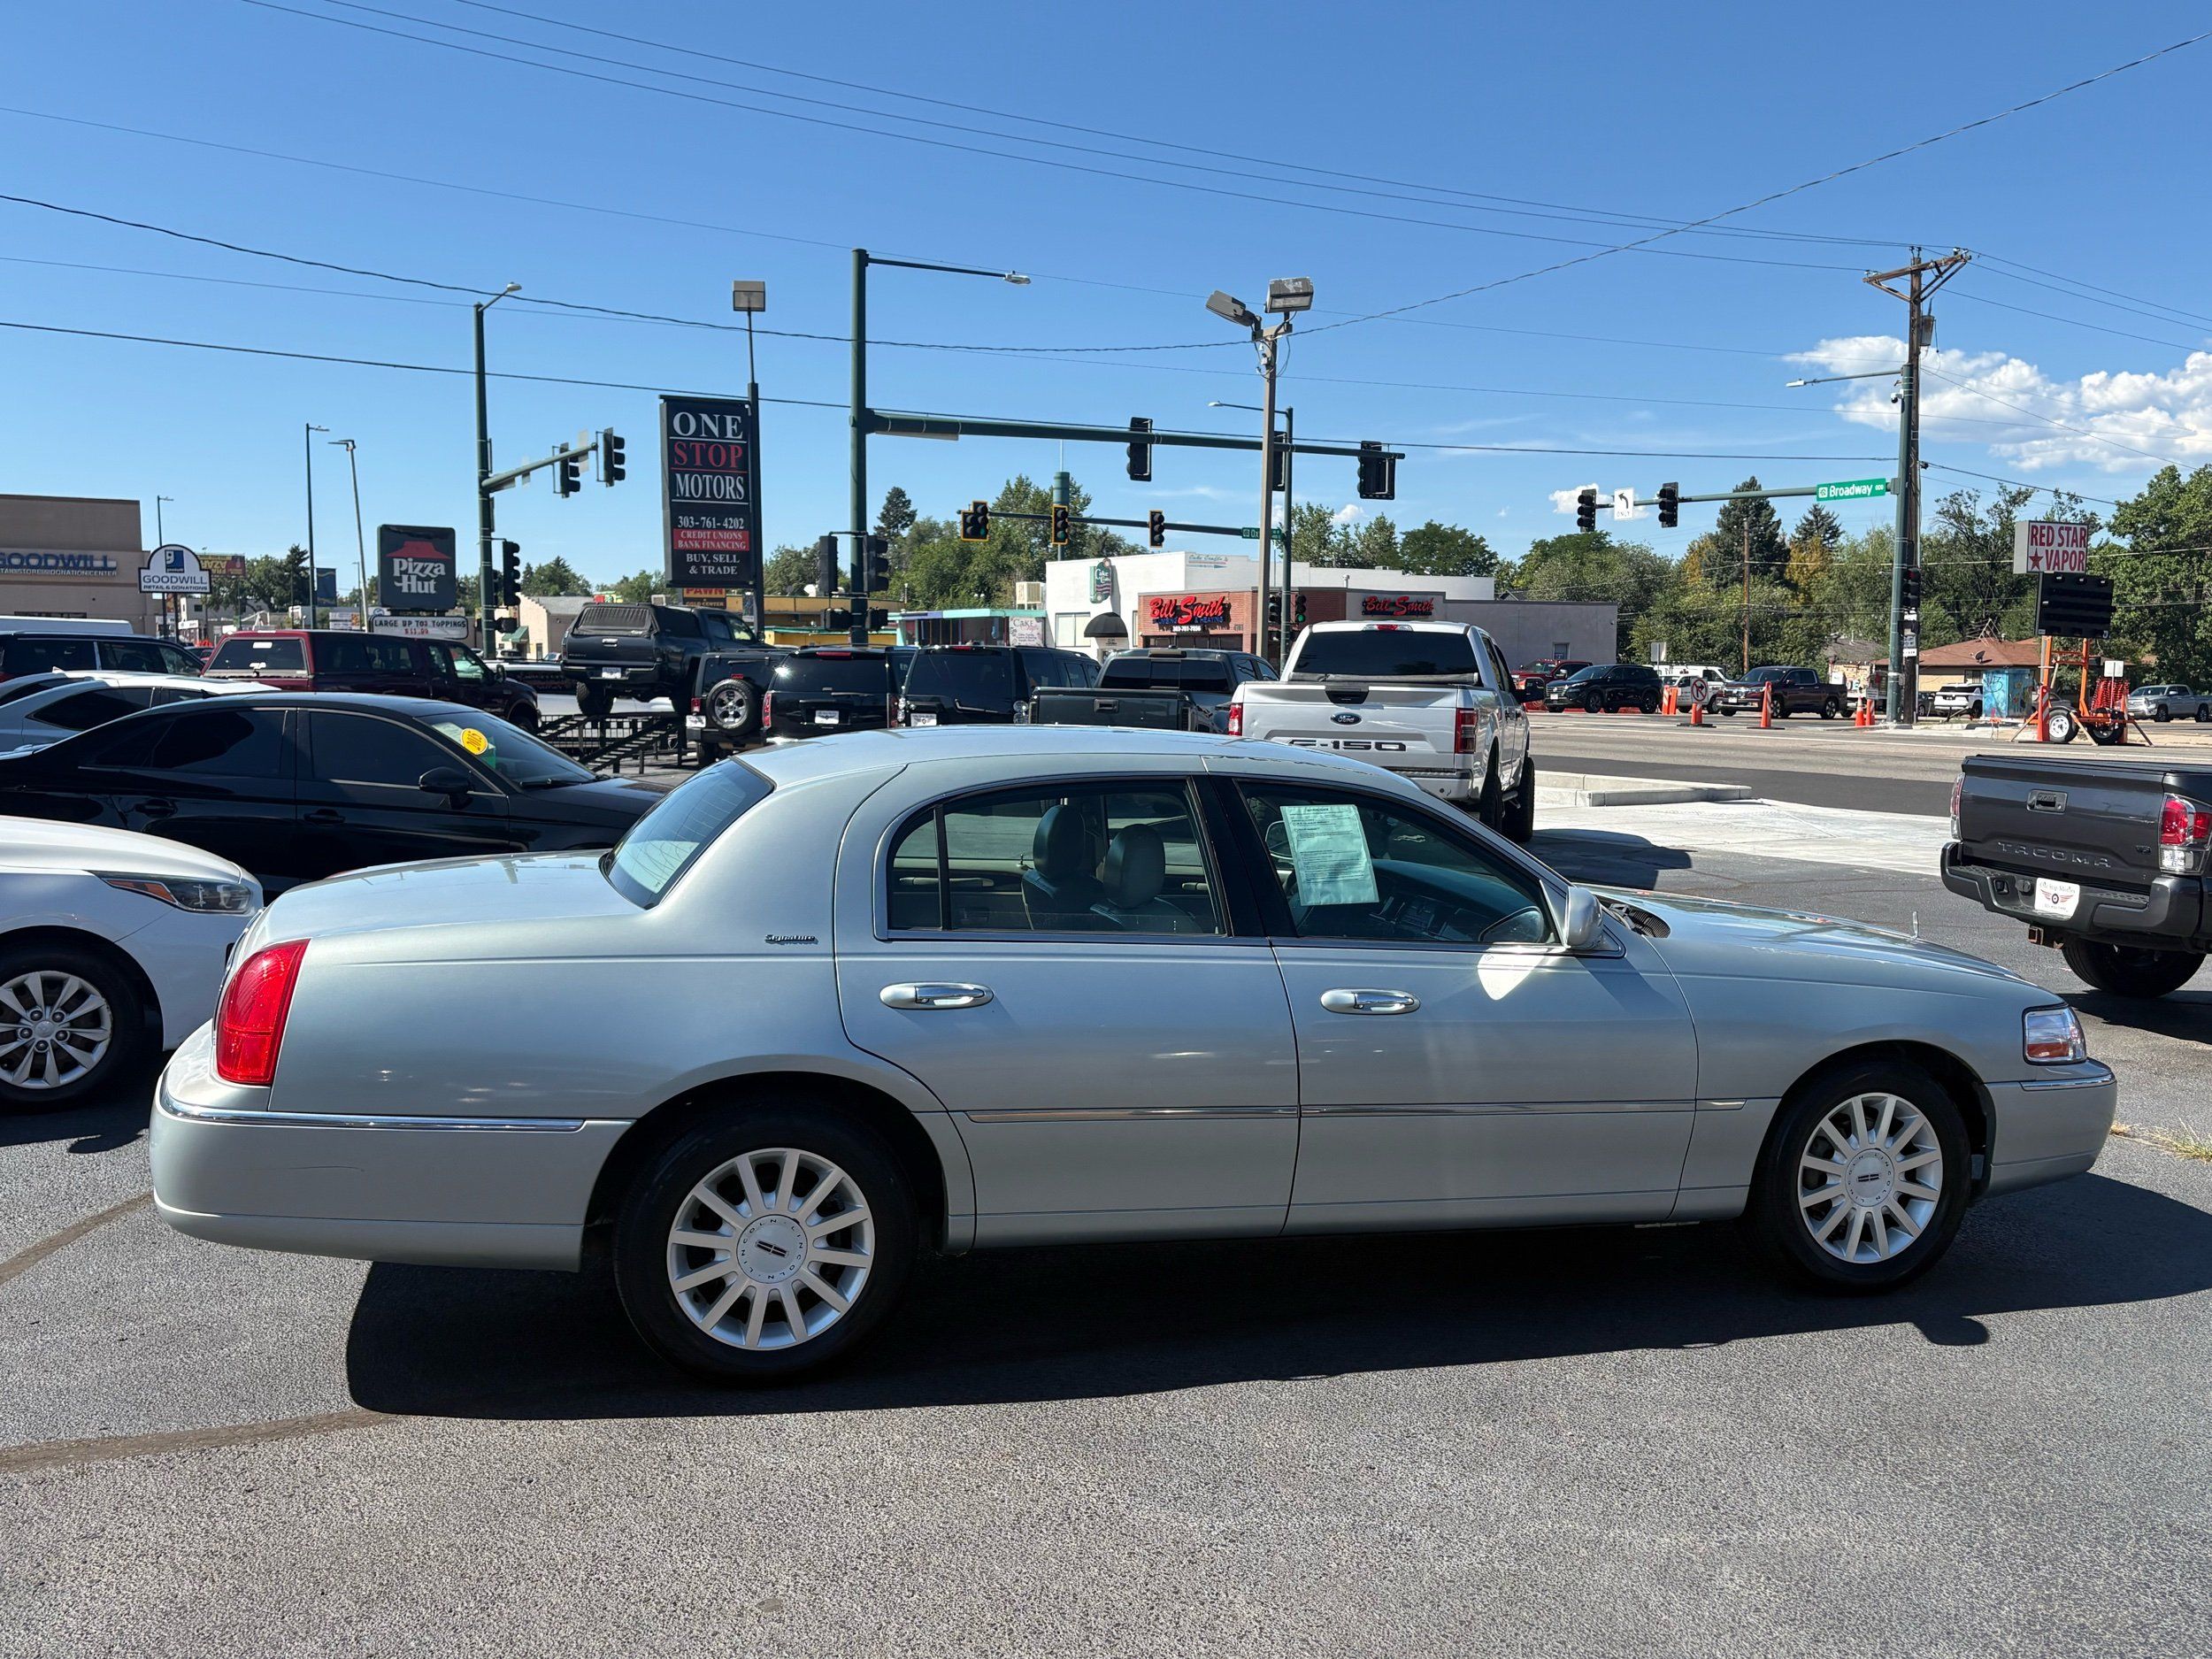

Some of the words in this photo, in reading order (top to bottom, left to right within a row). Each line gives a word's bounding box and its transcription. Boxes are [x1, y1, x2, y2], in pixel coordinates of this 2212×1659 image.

[672, 411, 743, 439] ONE
[673, 441, 742, 468] STOP
[675, 472, 744, 500] MOTORS
[1829, 484, 1872, 497] Broadway
[678, 516, 744, 529] 303-761-4202
[678, 540, 700, 549] BANK
[702, 540, 746, 549] FINANCING
[712, 531, 742, 540] UNIONS
[2030, 525, 2055, 547] RED
[2057, 526, 2086, 548] STAR
[393, 557, 446, 578] Pizza
[686, 554, 711, 564] BUY,
[713, 554, 740, 564] SELL
[2045, 549, 2085, 571] VAPOR
[142, 574, 208, 585] GOODWILL
[689, 565, 698, 574] &
[700, 565, 738, 575] TRADE
[394, 574, 436, 594] Hut
[1149, 598, 1177, 618] Bill
[1178, 595, 1225, 624] Smith
[1365, 596, 1392, 611] Bill
[1394, 596, 1434, 616] Smith
[1288, 740, 1407, 751] F-150
[1997, 841, 2111, 868] TACOMA
